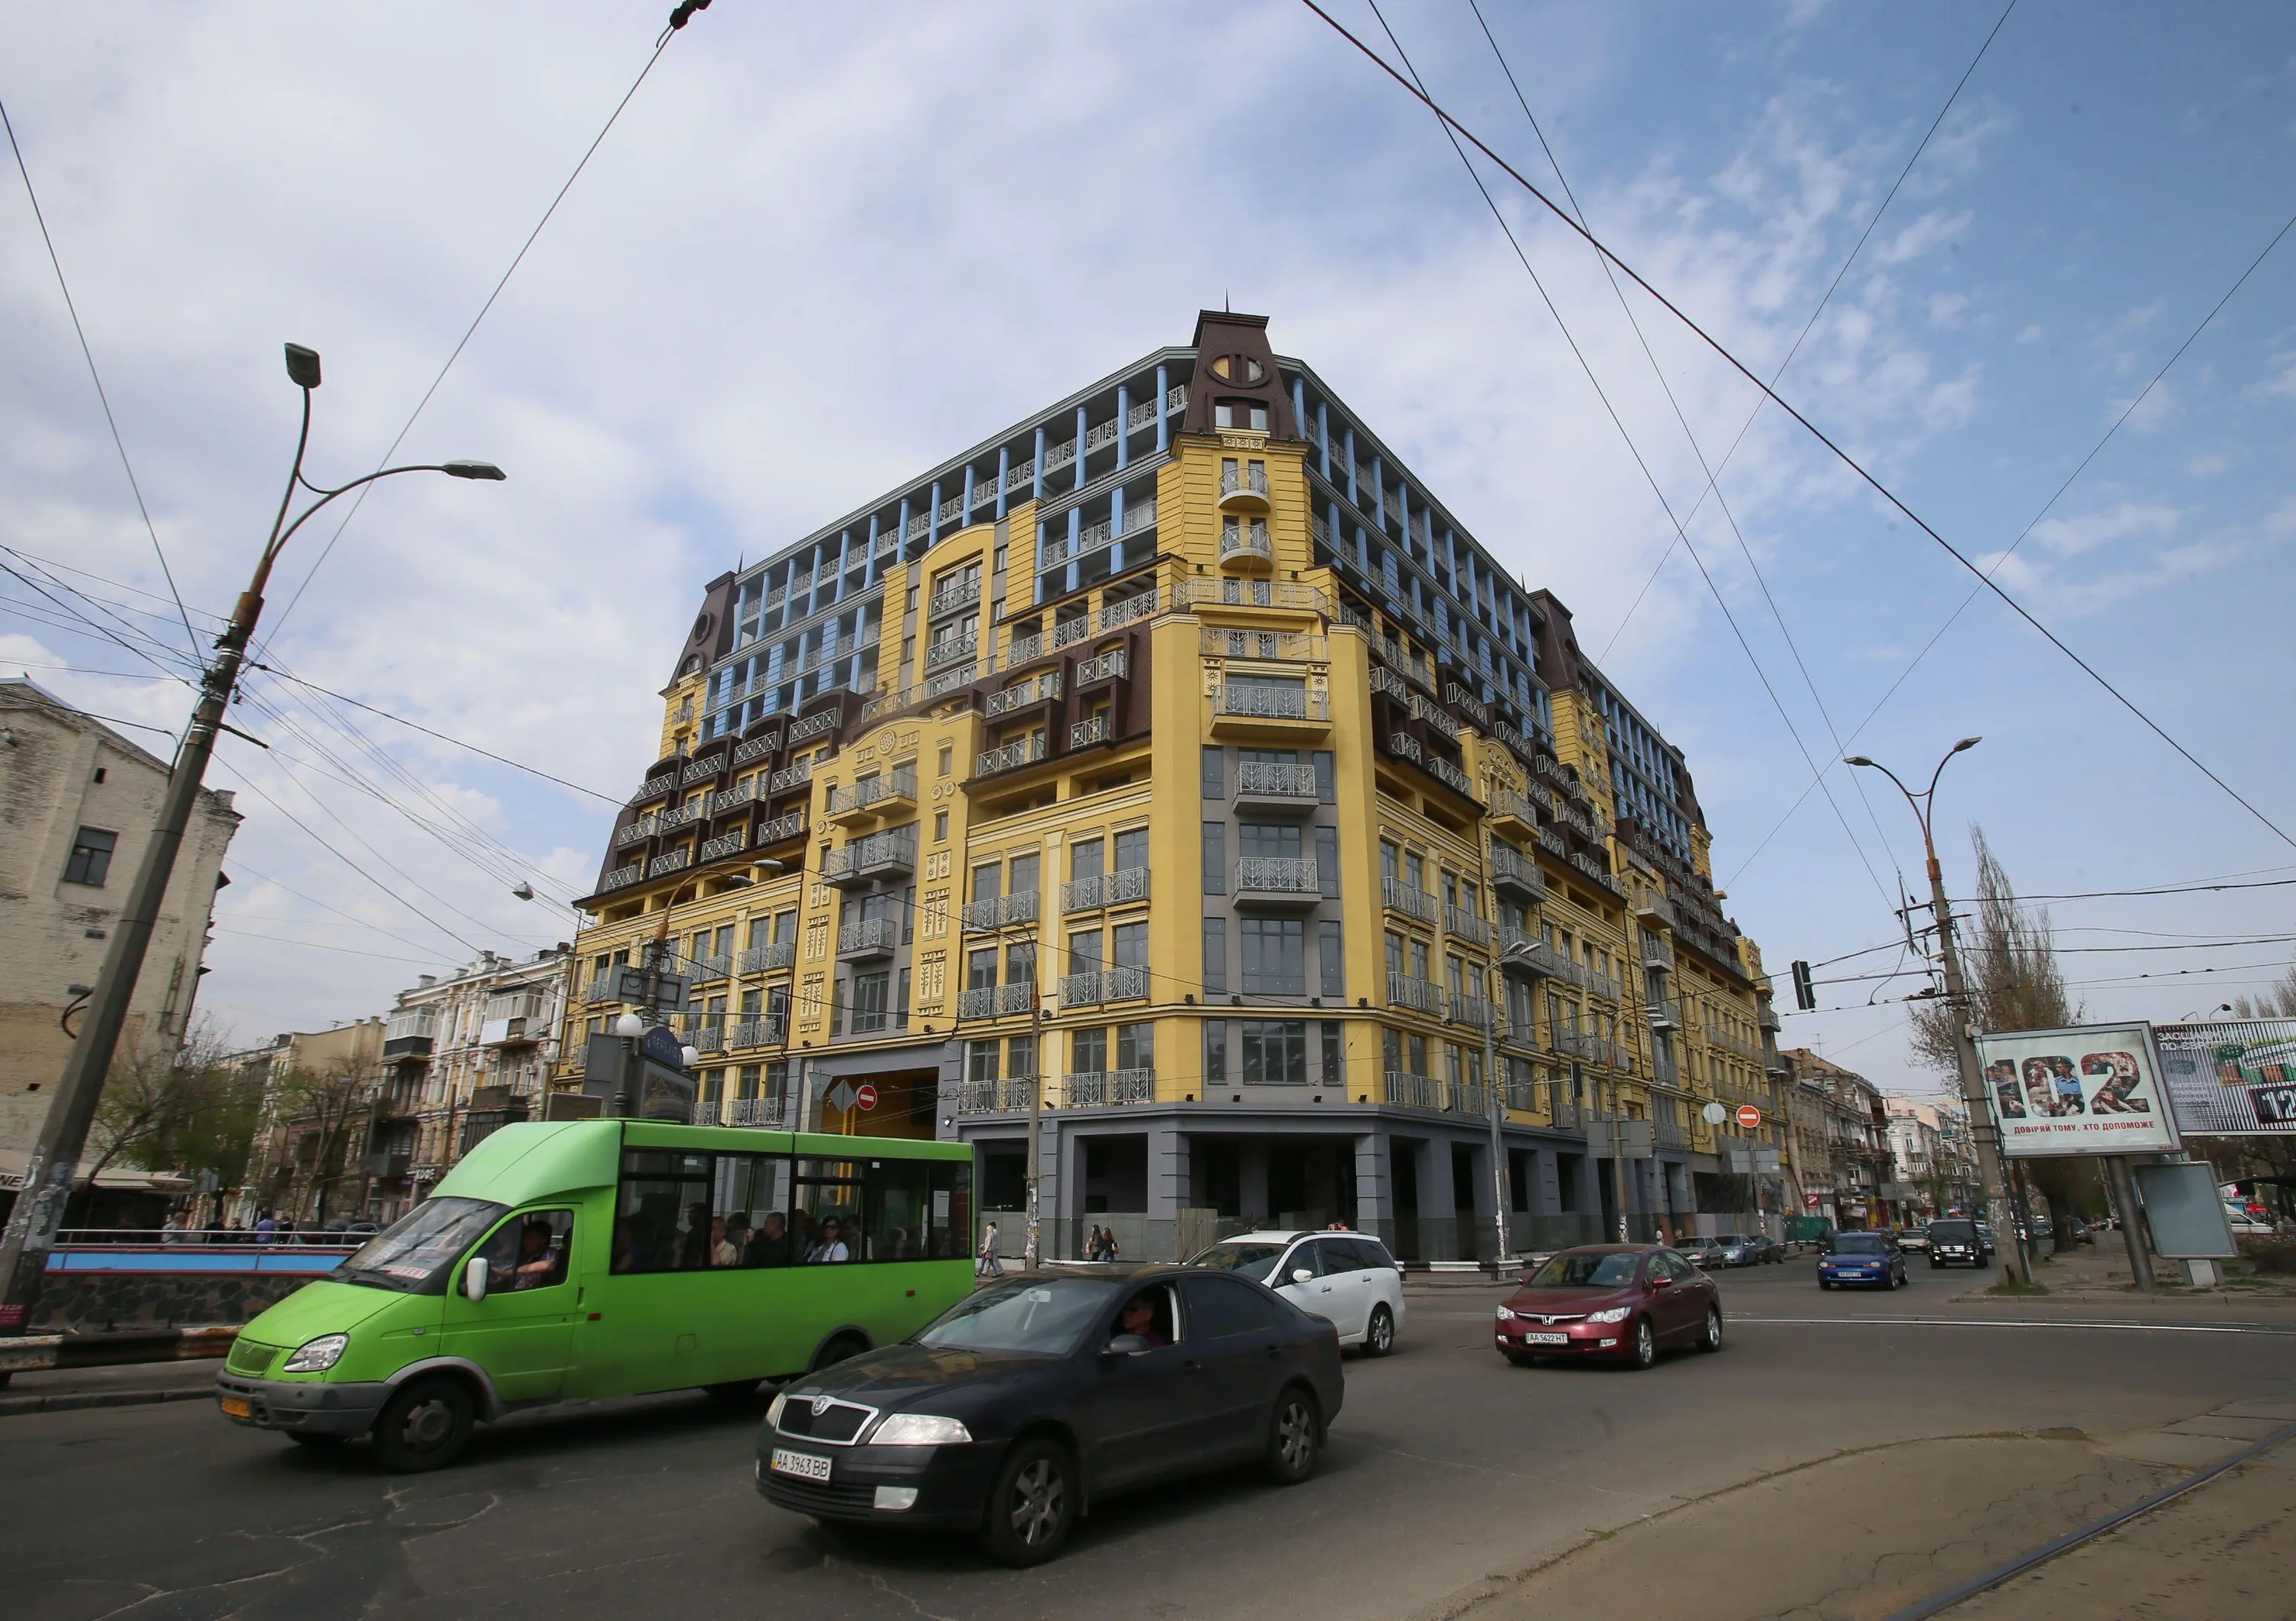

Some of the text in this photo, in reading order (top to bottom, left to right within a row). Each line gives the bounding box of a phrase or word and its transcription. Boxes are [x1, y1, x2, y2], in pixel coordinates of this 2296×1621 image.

[1984, 1052, 2151, 1118] 102
[2014, 1124, 2051, 1134] ДОВІРЯЙ
[2102, 1120, 2154, 1131] ДОПОМОЖЕ
[776, 1453, 829, 1477] AA 3963 BB
